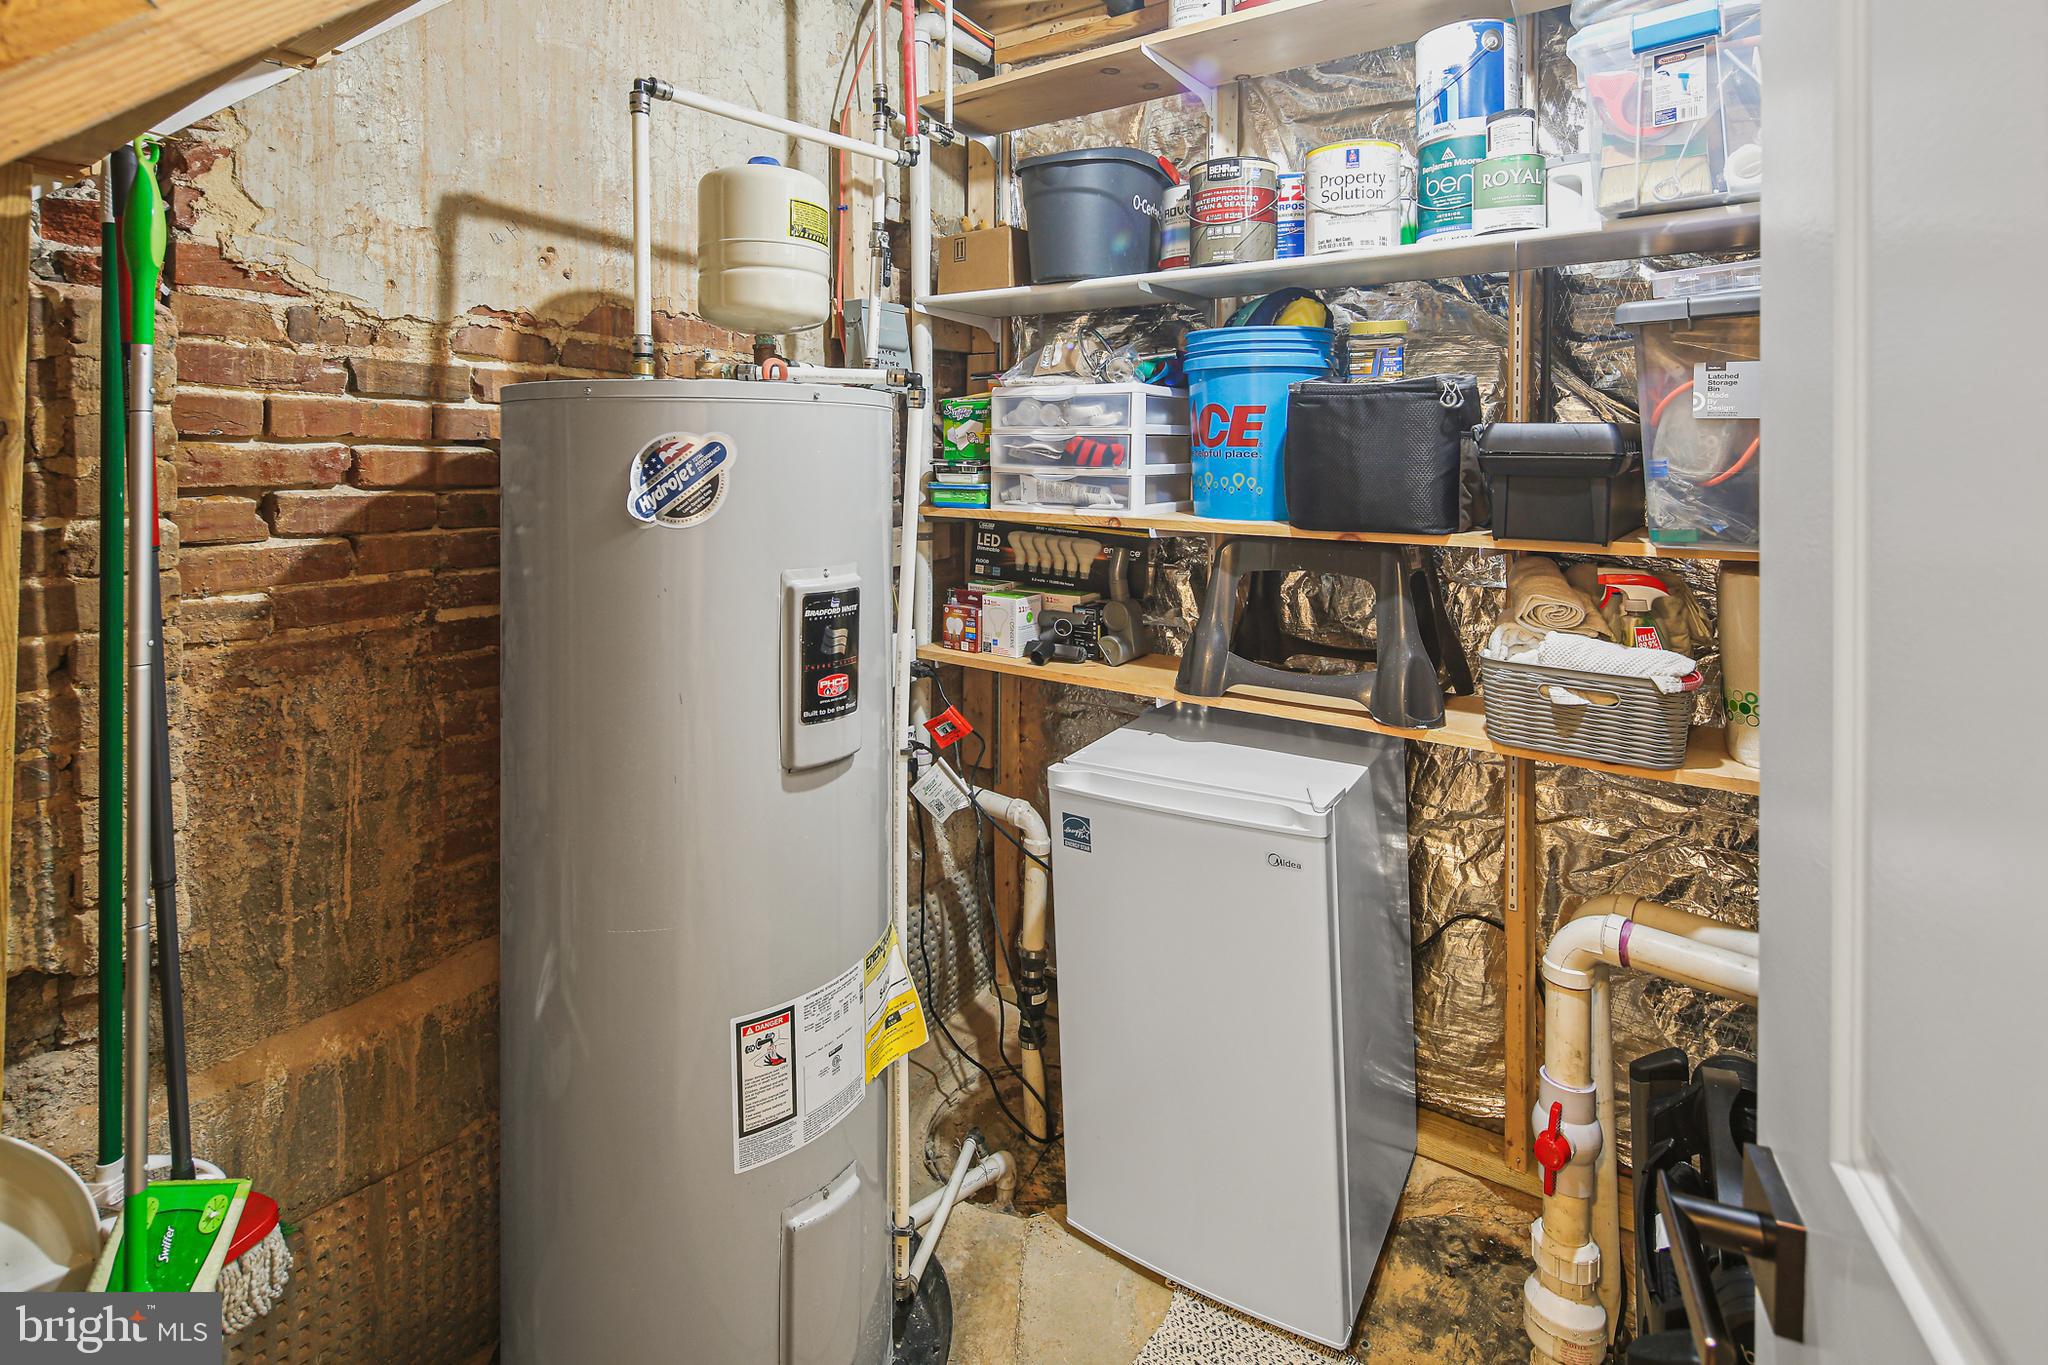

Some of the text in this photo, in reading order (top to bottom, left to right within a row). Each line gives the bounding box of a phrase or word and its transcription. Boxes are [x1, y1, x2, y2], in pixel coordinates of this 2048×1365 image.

[1208, 163, 1231, 175] BEHR
[1422, 159, 1453, 176] Benjamin
[1208, 171, 1240, 180] PREMIUM
[1320, 171, 1386, 189] Property
[1482, 167, 1543, 190] ROYAL
[1426, 173, 1473, 197] ben
[1321, 186, 1384, 204] Solution
[1223, 201, 1257, 213] SEALER
[1278, 202, 1305, 212] RPOS
[1191, 399, 1267, 448] ACE
[1225, 449, 1263, 459] place.
[639, 461, 695, 513] Hydrojet
[977, 532, 1001, 547] LED
[976, 545, 1001, 553] Dimmable
[804, 603, 858, 618] BRADFORD WHITE
[1637, 632, 1656, 642] KILLS
[820, 676, 848, 689] PHCC
[803, 710, 819, 718] Built
[755, 1017, 784, 1032] DANGER
[158, 1225, 175, 1263] Swiffer
